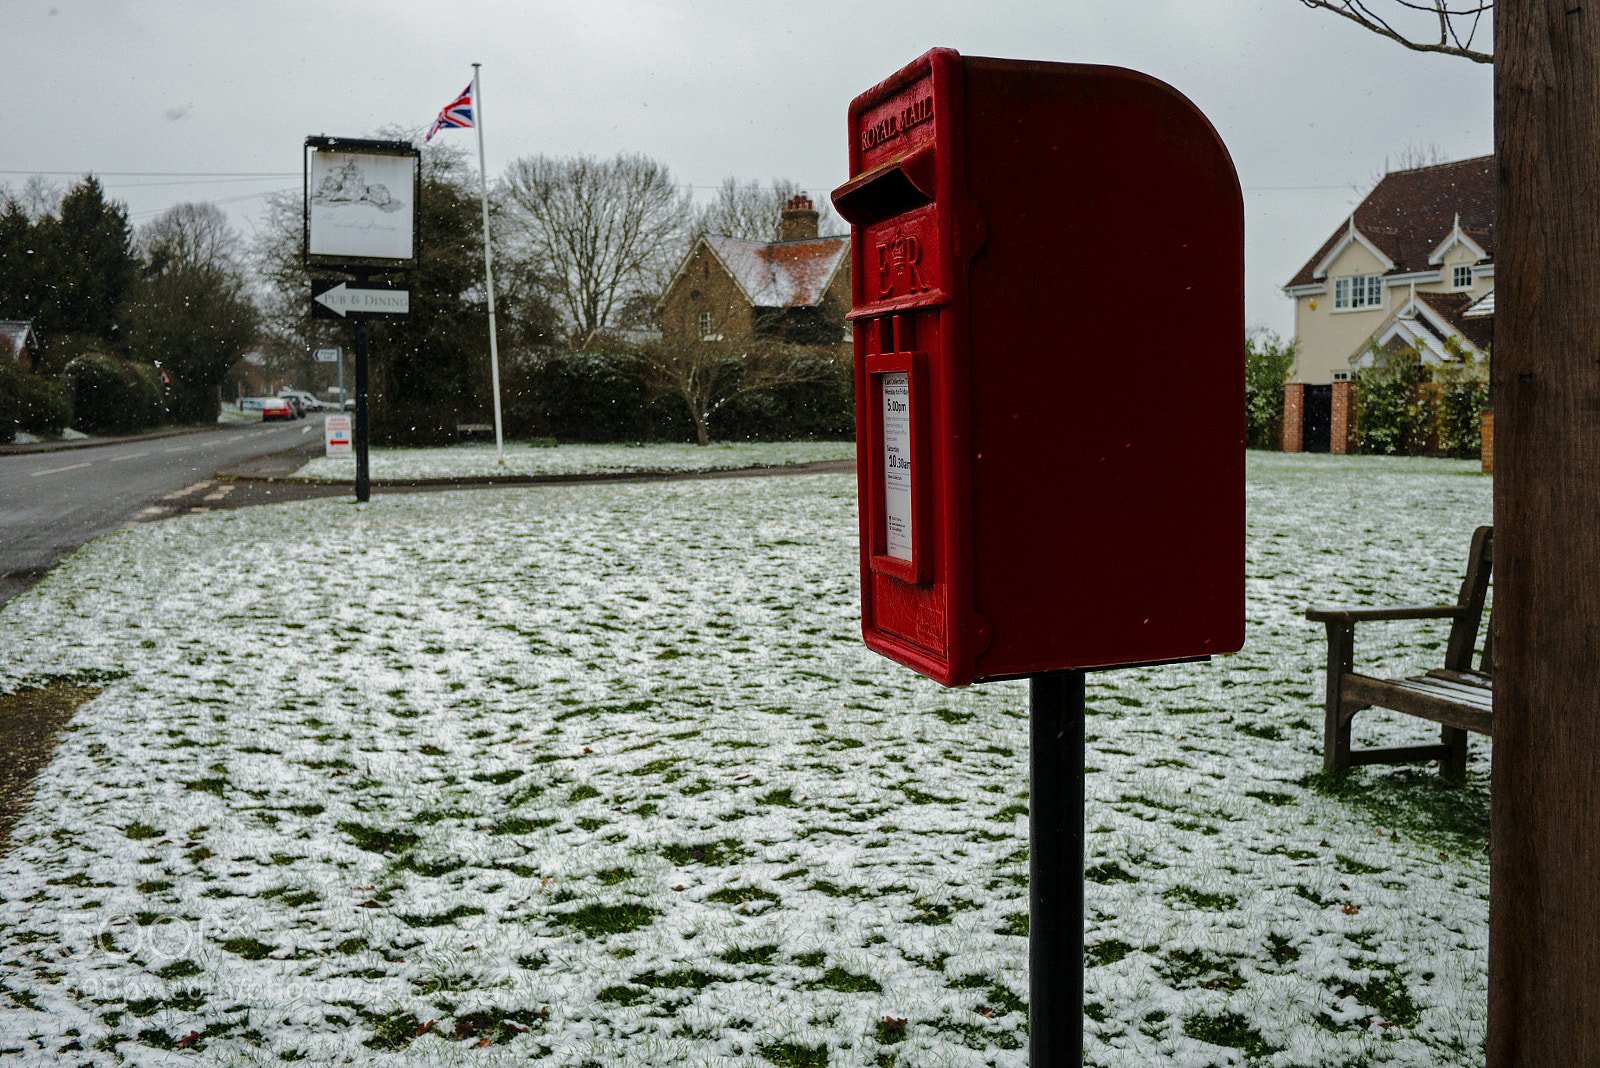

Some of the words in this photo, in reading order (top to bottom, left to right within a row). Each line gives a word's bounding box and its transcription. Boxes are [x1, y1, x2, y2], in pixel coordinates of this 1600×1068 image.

[862, 116, 898, 151] ROYAL
[900, 96, 934, 133] MAIL
[324, 293, 346, 304] PUB
[351, 295, 360, 305] &
[365, 295, 408, 307] DINING
[887, 398, 907, 413] 5.00pm
